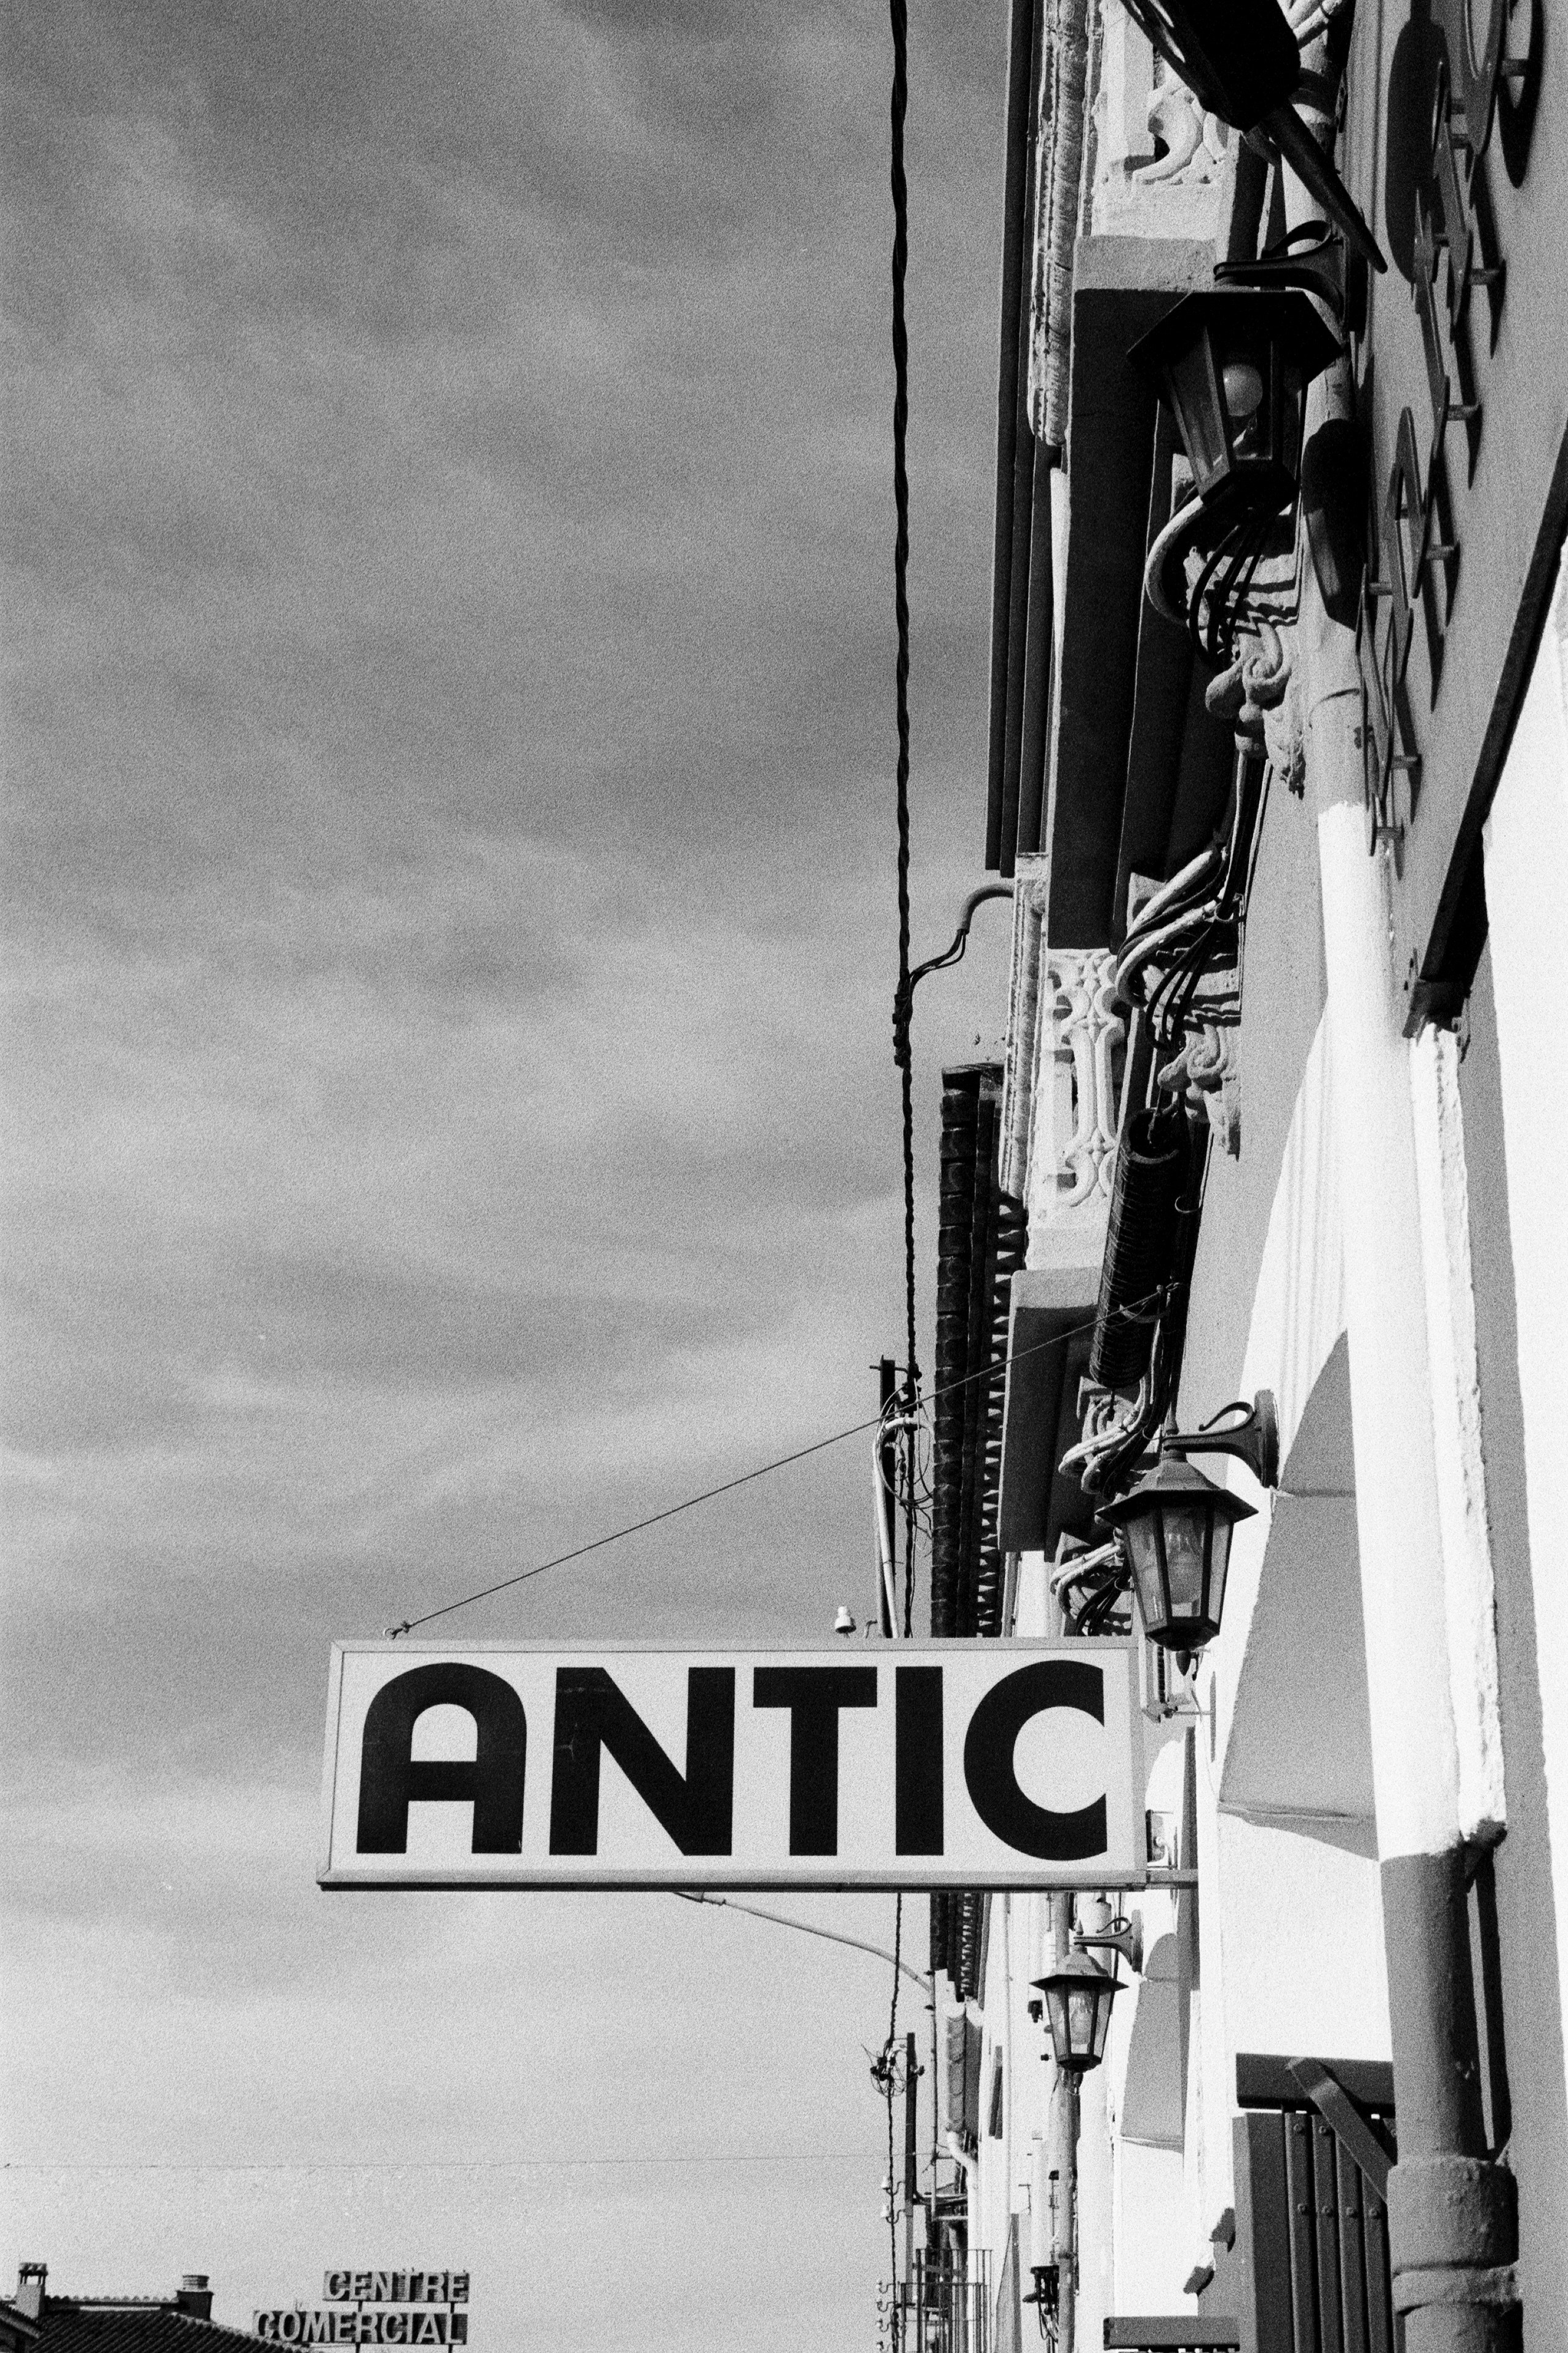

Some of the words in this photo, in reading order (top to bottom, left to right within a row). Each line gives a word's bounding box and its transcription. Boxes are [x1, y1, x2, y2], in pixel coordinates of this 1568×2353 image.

[356, 1660, 1107, 1861] ANTIC
[323, 2271, 469, 2303] CENTRE
[253, 2311, 467, 2345] COMERCIAL
